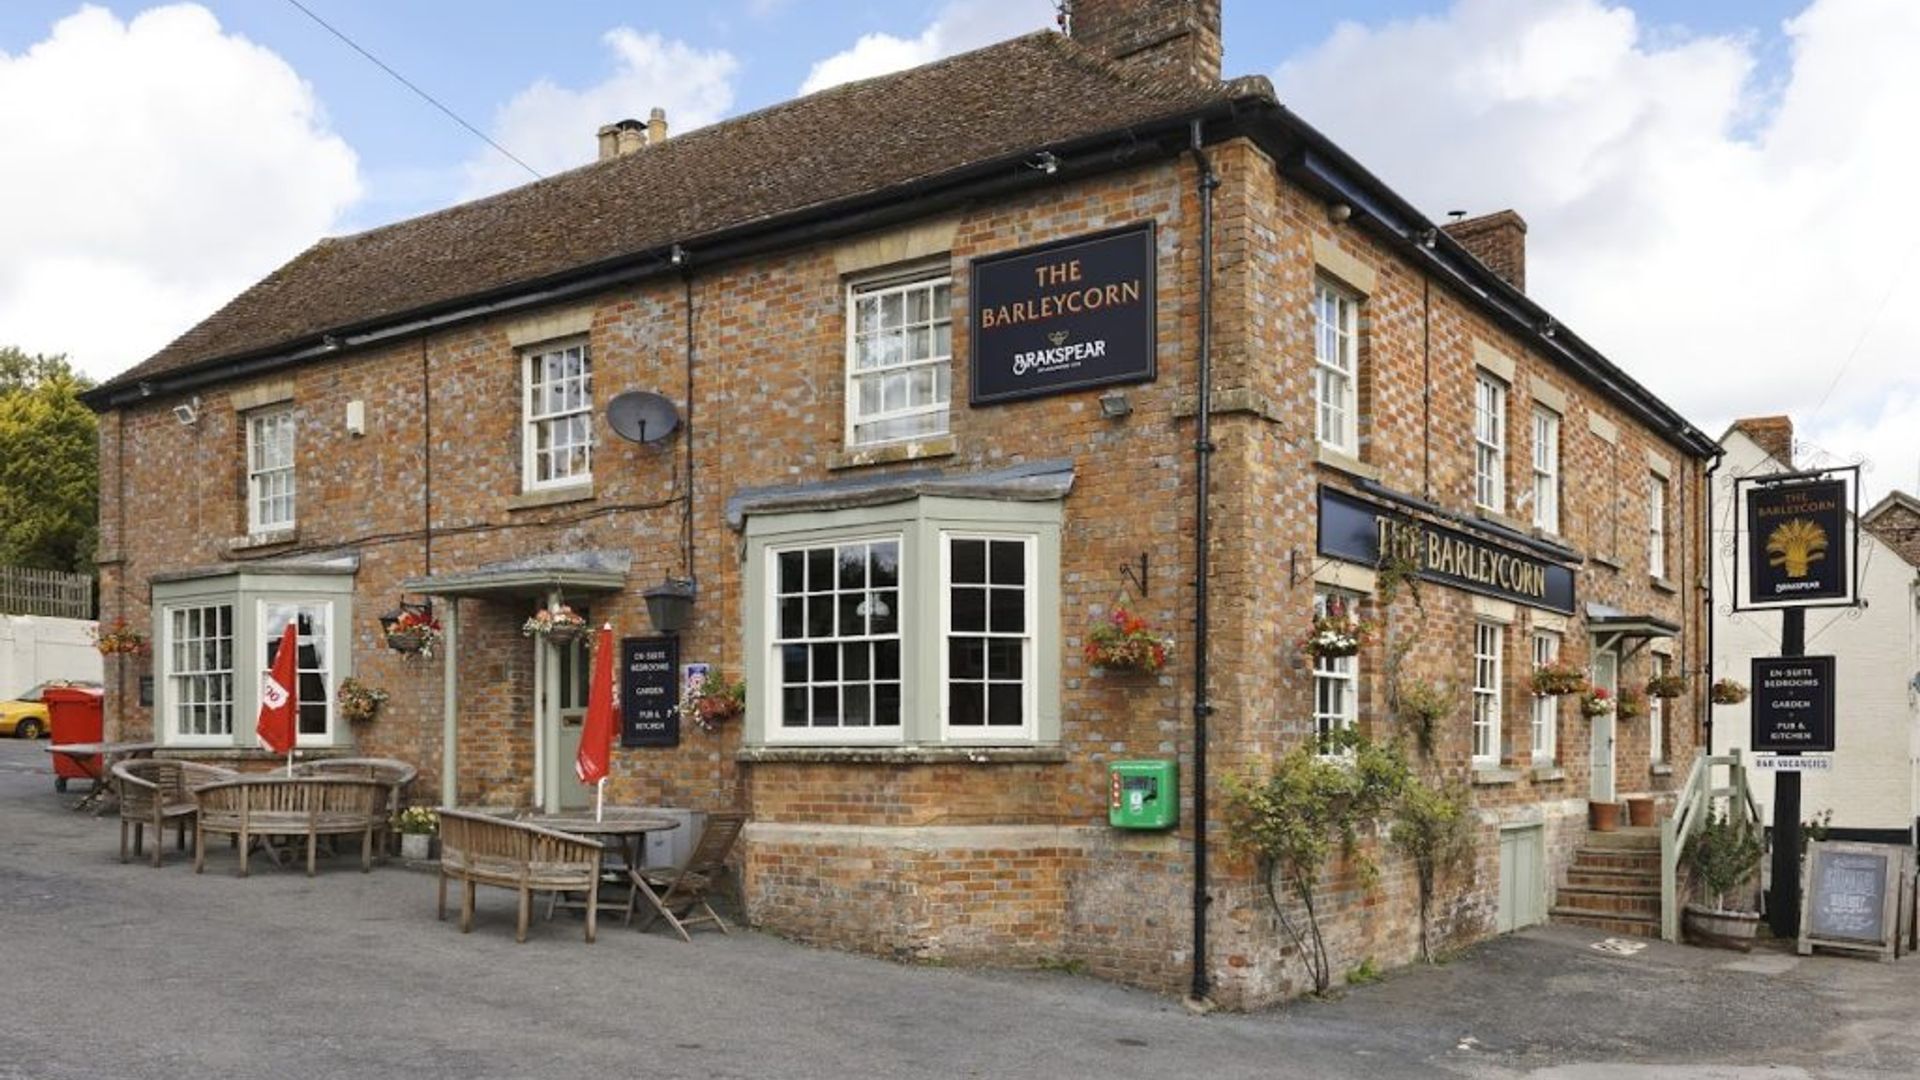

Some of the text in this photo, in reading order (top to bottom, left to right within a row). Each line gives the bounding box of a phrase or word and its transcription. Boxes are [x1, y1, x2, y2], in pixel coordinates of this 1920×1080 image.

[1035, 260, 1083, 287] THE
[981, 279, 1141, 329] BARLEYCORN
[1012, 339, 1107, 376] BRAKSPEAR
[1785, 492, 1808, 504] THE
[1427, 531, 1545, 598] BARLEYCORN
[1769, 668, 1813, 677] EN-SUITE
[1764, 679, 1819, 688] BEDROOMS
[635, 687, 664, 695] GARDEN
[1771, 700, 1811, 709] GARDEN
[1777, 721, 1806, 730] PUB &
[1770, 732, 1812, 740] KITCHEN
[1777, 759, 1828, 769] VACANCIES
